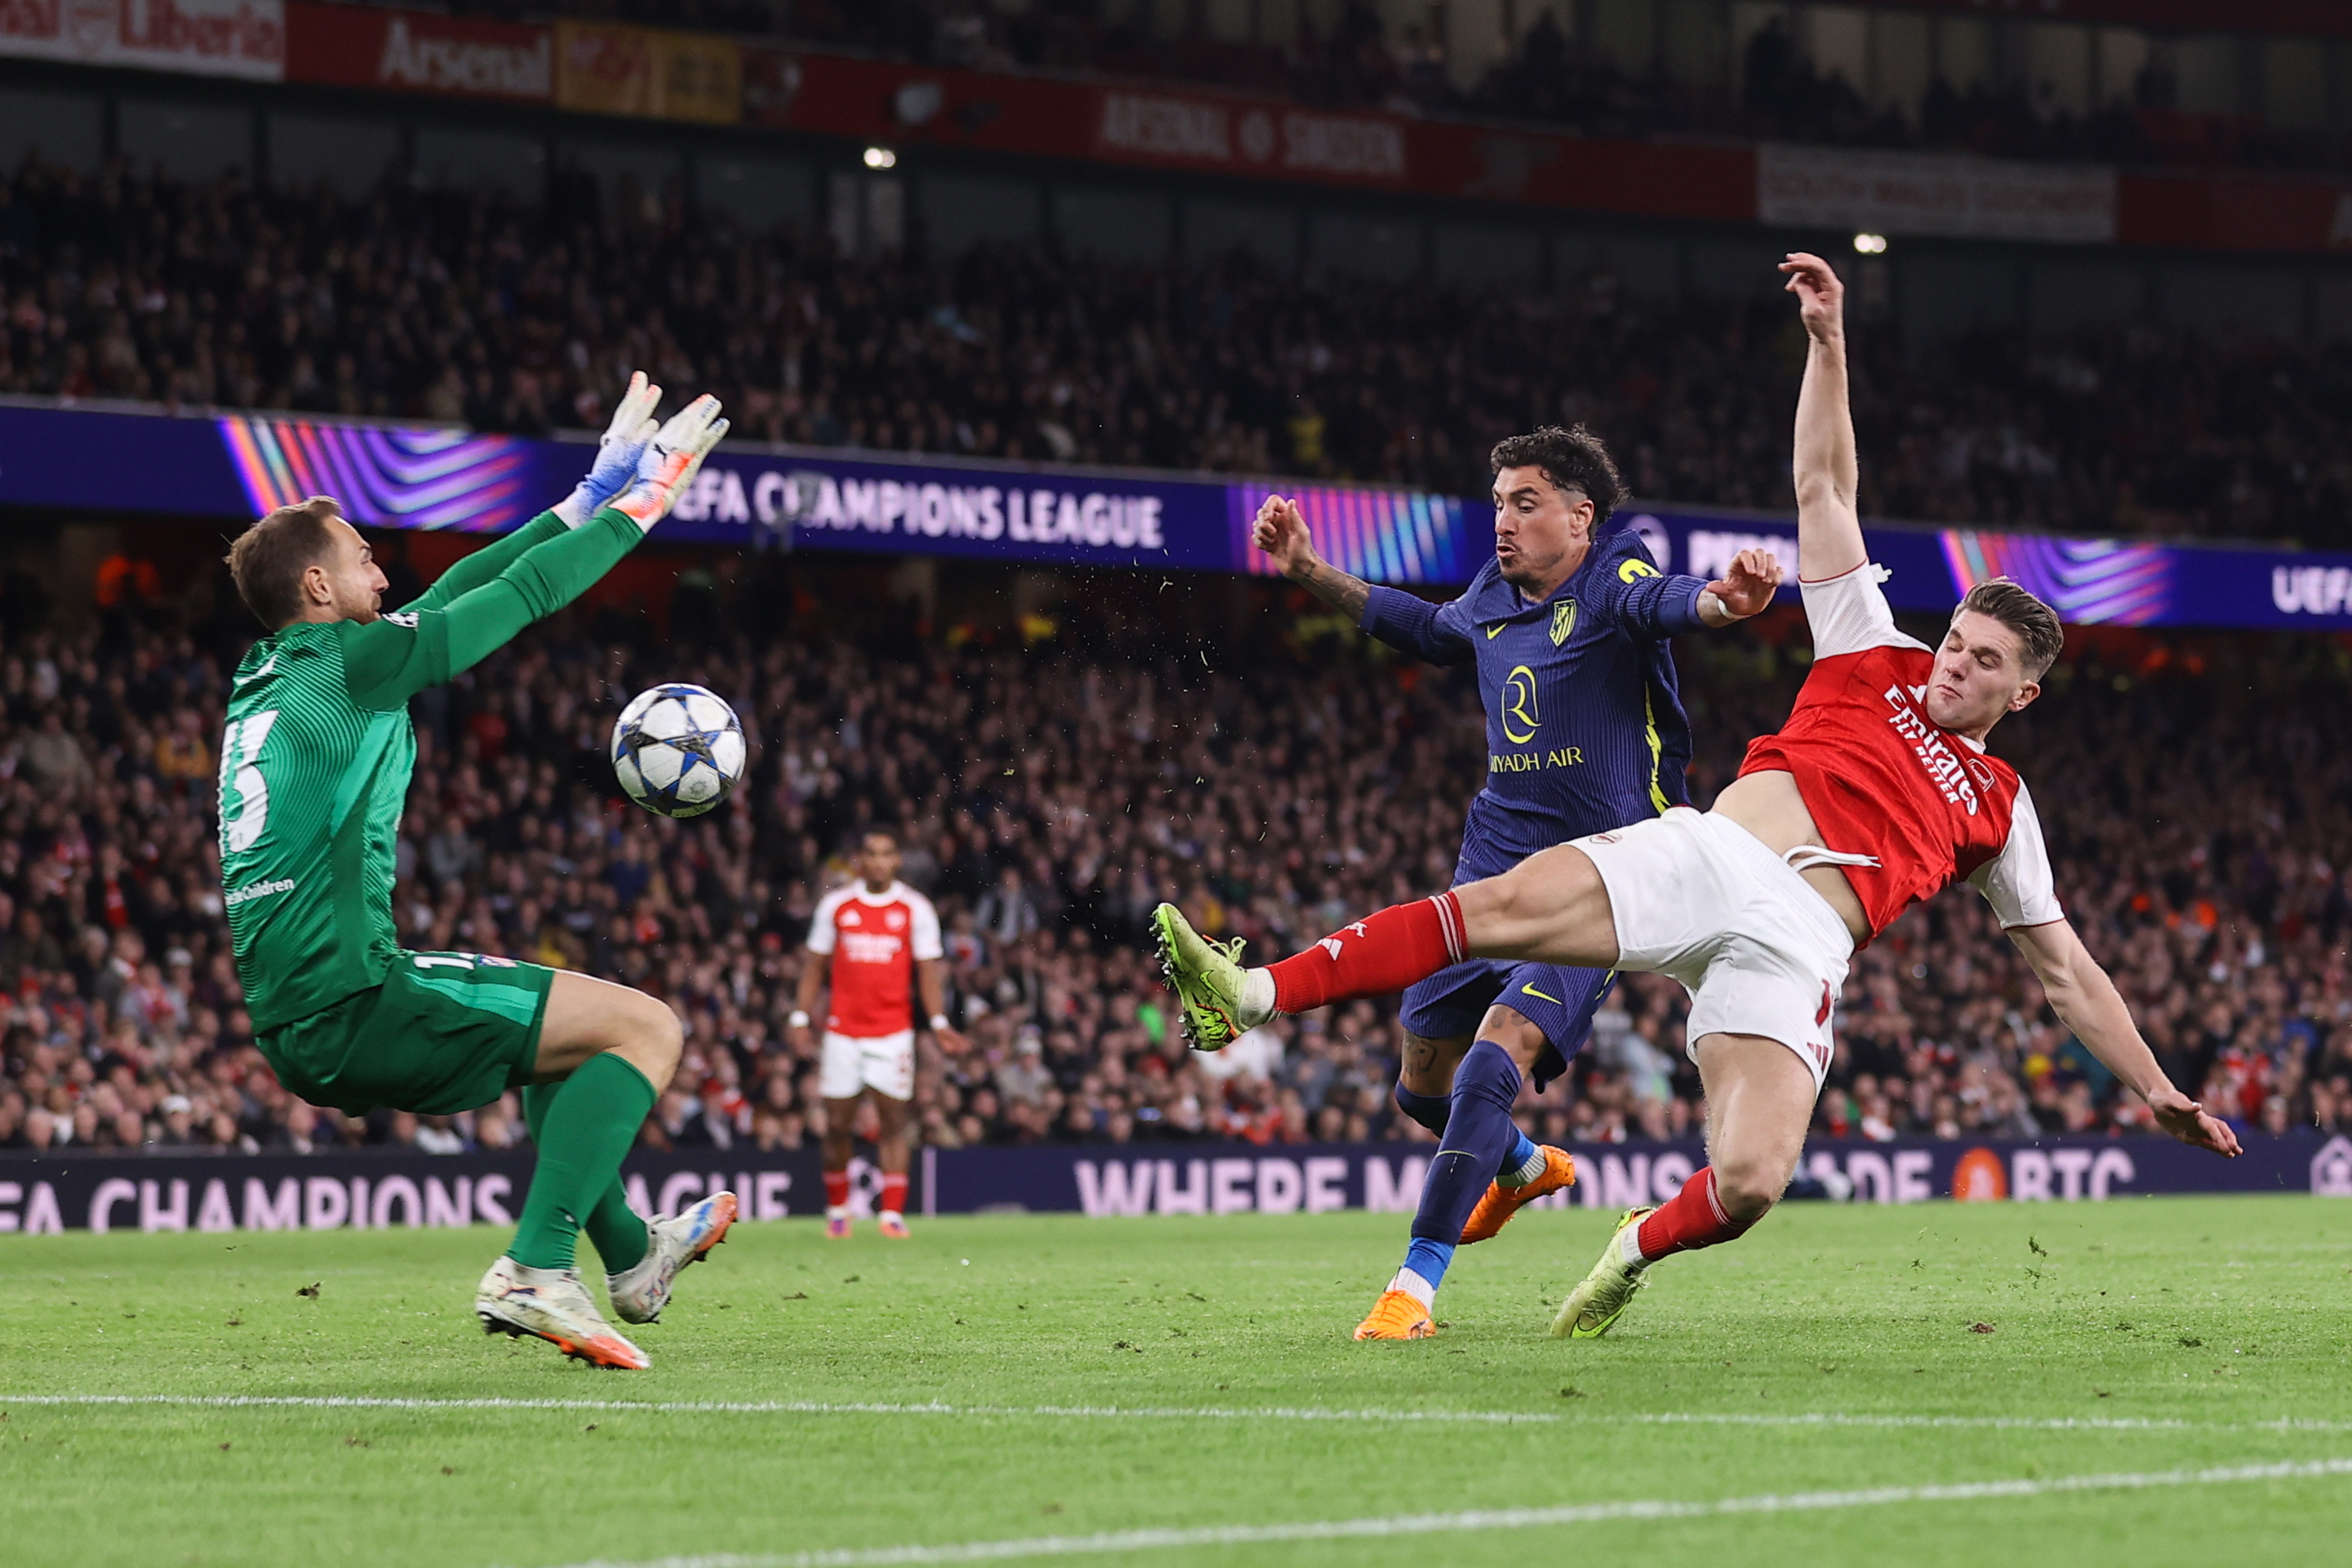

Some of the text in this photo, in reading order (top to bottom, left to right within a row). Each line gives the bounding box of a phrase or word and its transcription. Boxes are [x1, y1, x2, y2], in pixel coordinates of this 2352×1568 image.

[381, 15, 551, 98] Arsenal
[670, 467, 750, 523] EFA
[1007, 487, 1166, 549] LEAGUE
[2271, 563, 2352, 615] UEF
[1884, 683, 1978, 816] Emirates
[1888, 713, 1918, 739] FLY
[1546, 746, 1584, 769] AIR
[87, 1173, 513, 1234] CHAMPIONS
[623, 1170, 793, 1224] AGUE
[1074, 1156, 1349, 1217] WHERE
